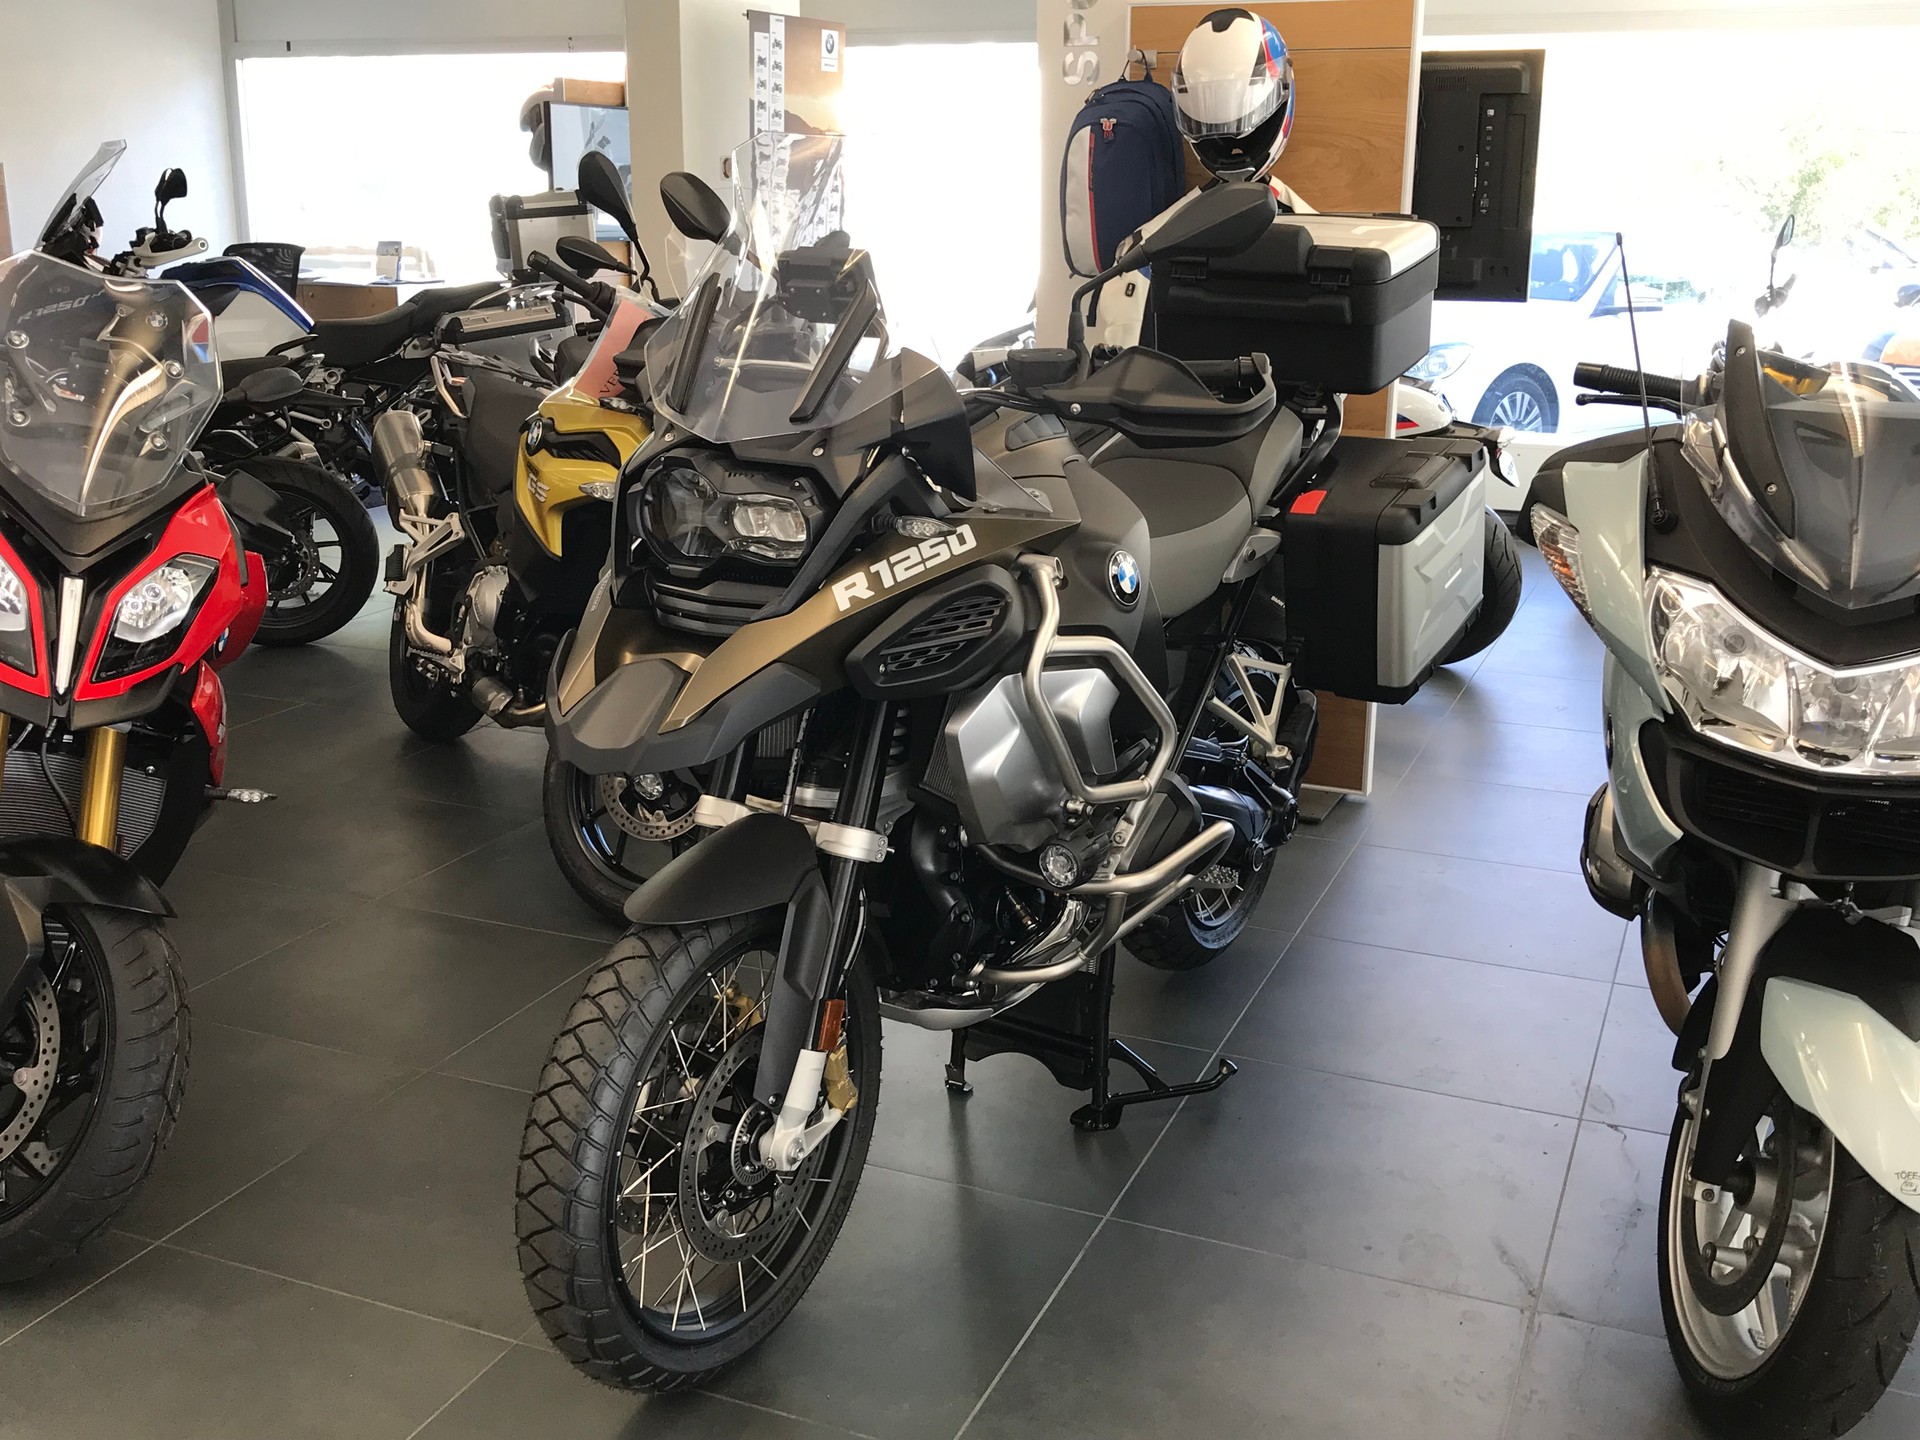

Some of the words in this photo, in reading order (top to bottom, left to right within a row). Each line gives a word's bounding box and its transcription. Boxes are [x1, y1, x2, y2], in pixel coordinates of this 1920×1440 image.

[1063, 0, 1099, 85] SP
[831, 571, 875, 612] R
[869, 523, 978, 589] 1250
